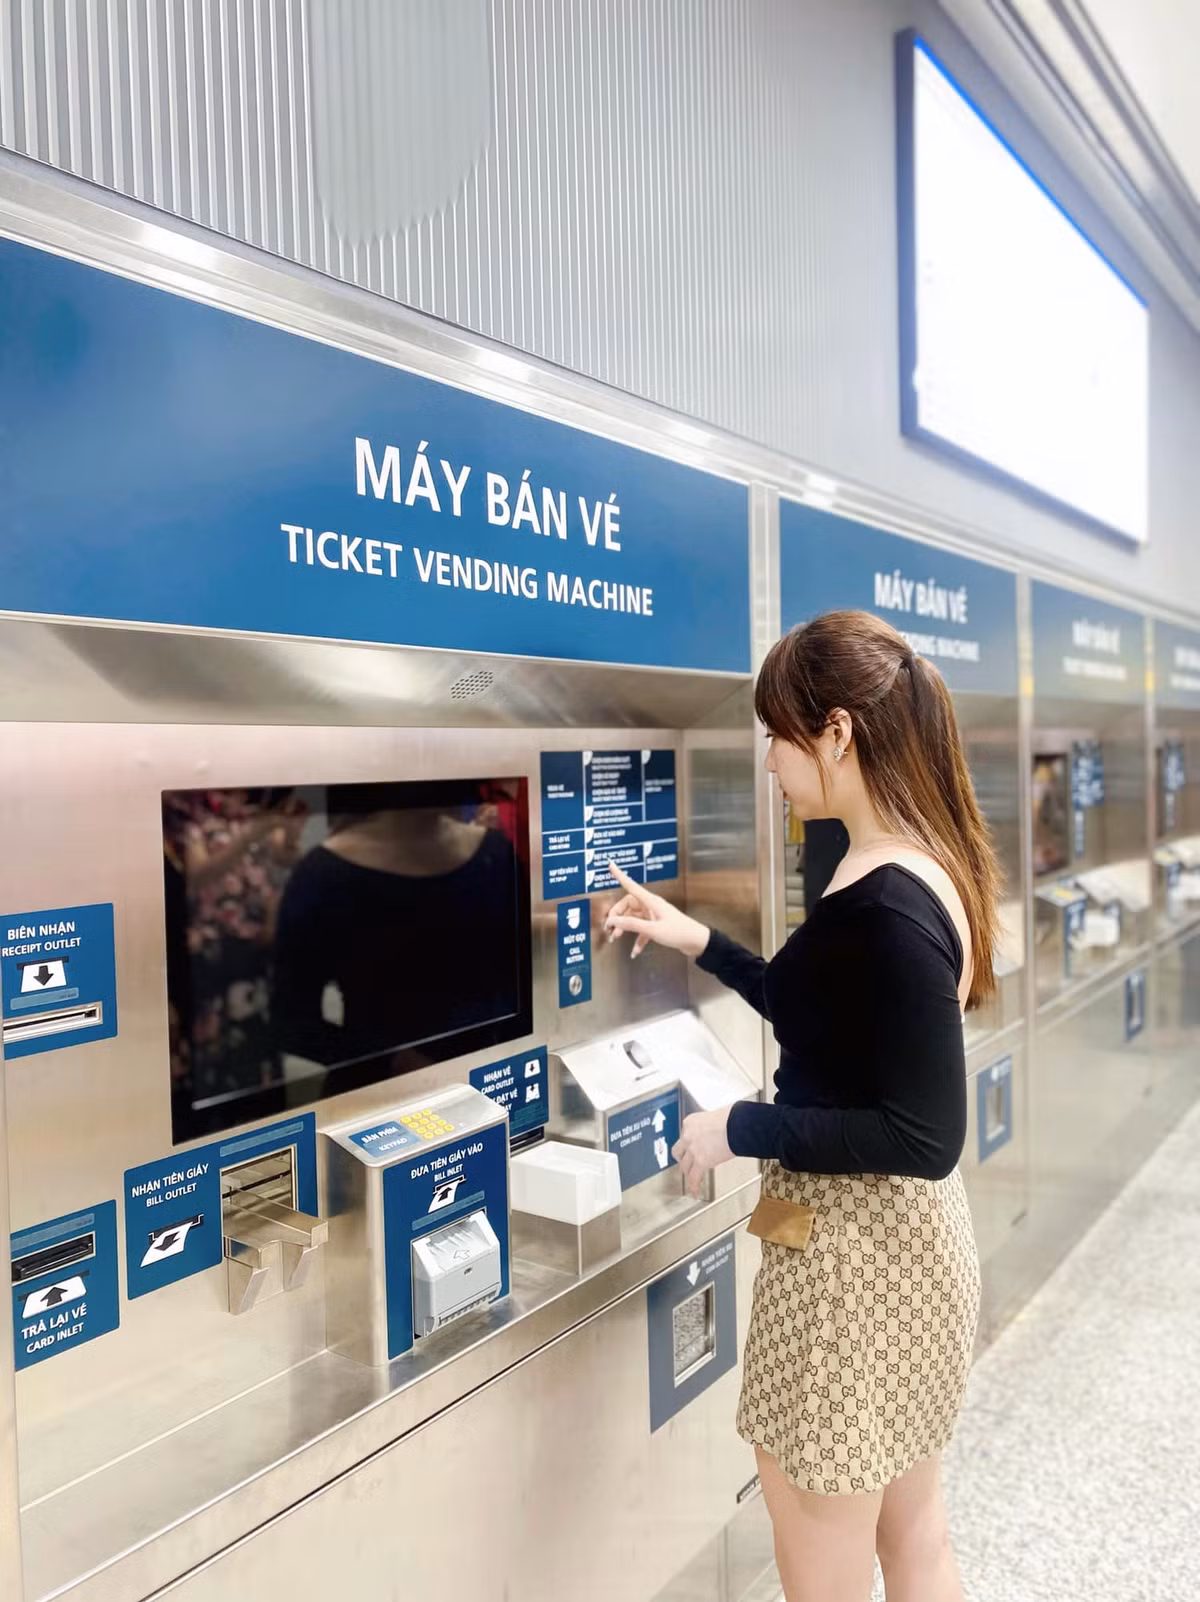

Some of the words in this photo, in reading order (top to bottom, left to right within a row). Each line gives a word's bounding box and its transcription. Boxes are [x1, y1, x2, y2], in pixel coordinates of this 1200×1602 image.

[355, 437, 471, 517] MÁY
[487, 469, 567, 540] BÁN
[578, 493, 622, 551] VÉ
[280, 523, 403, 578] TICKET
[413, 547, 538, 599] VENDING
[547, 571, 654, 616] MACHINE
[874, 569, 914, 612] MÁY
[916, 578, 947, 620] BÁN
[948, 586, 969, 624] VÉ
[7, 925, 35, 940] BIÊN
[39, 921, 75, 936] NHẬN
[2, 943, 42, 957] RECEIPT
[44, 937, 81, 951] OUTLET
[483, 1069, 503, 1084] NHẬN
[503, 1065, 511, 1077] VÉ
[481, 1084, 495, 1095] CARD
[496, 1077, 514, 1090] OUTLET
[510, 1087, 518, 1099] VÉ
[361, 1133, 379, 1144] BÀN
[380, 1126, 399, 1139] PHÍM
[379, 1138, 408, 1151] KEYPAD
[410, 1168, 429, 1179] ĐƯA
[430, 1157, 448, 1170] TIỀN
[448, 1149, 466, 1163] GIẤY
[466, 1142, 483, 1156] VÀO
[131, 1179, 160, 1198] NHẬN
[163, 1171, 184, 1187] TIỀN
[186, 1163, 209, 1179] GIẤY
[434, 1173, 446, 1182] BILL
[446, 1164, 464, 1177] INLET
[146, 1194, 164, 1207] BILL
[165, 1182, 197, 1200] OUTLET
[21, 1319, 47, 1340] TRẢ
[50, 1311, 69, 1328] LẠI
[72, 1302, 87, 1319] VÉ
[26, 1335, 55, 1353] CARD
[57, 1322, 84, 1341] INLET
